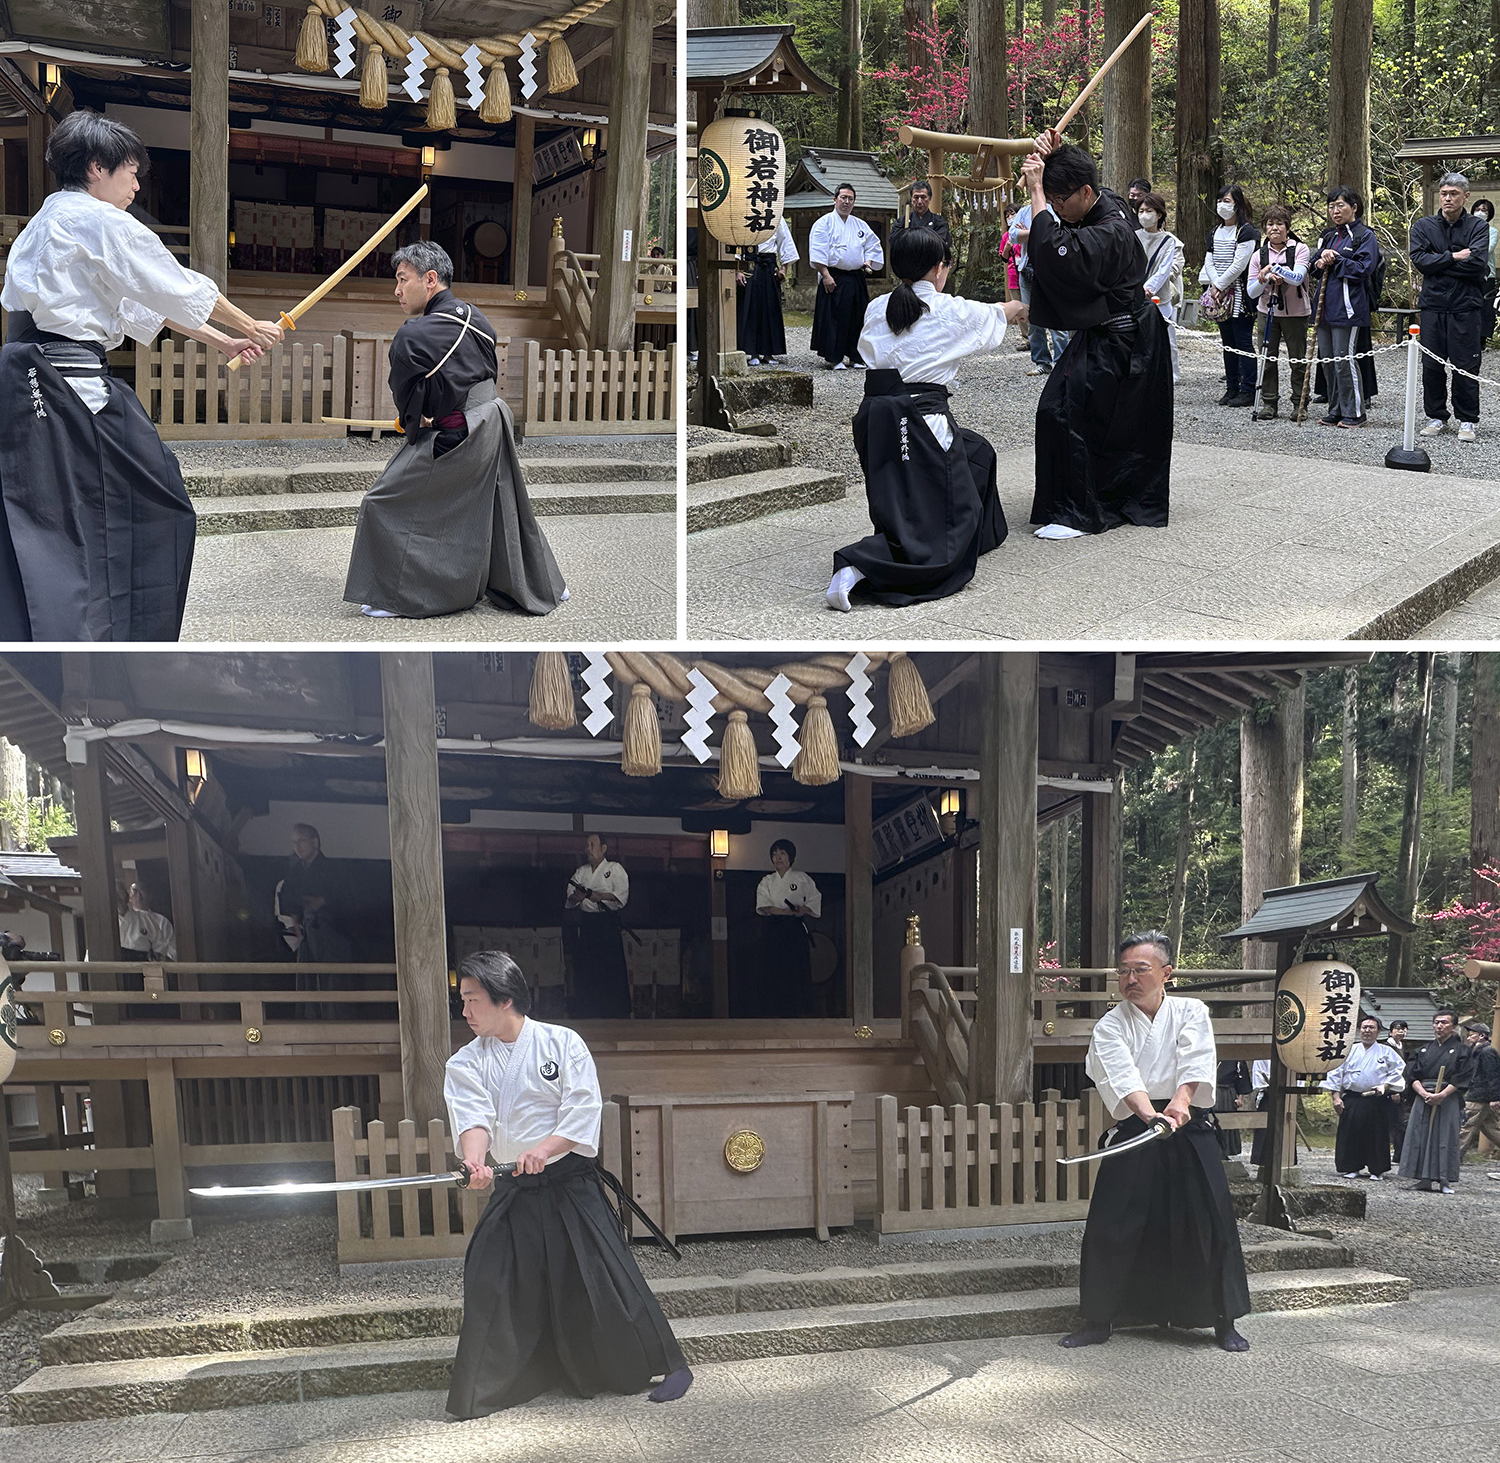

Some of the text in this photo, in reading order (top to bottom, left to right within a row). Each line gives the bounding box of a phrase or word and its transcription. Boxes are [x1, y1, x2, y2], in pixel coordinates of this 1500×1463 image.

[742, 128, 779, 233] 御岩神社
[1315, 969, 1354, 1062] 御岩神社
